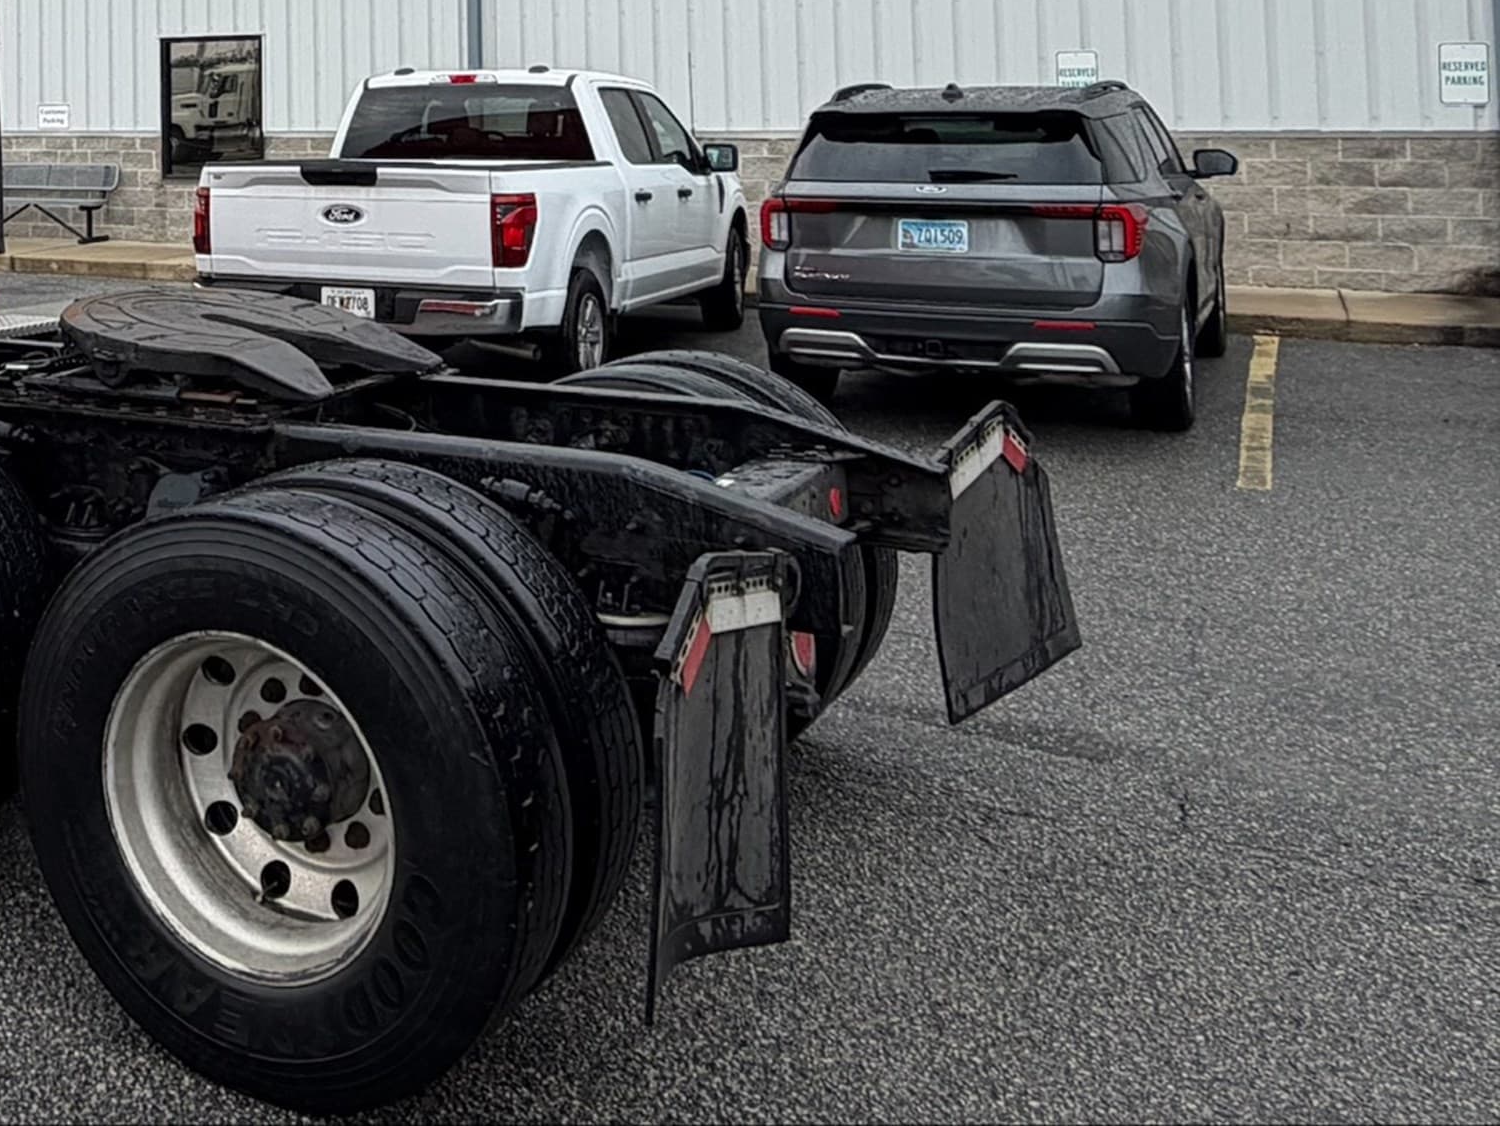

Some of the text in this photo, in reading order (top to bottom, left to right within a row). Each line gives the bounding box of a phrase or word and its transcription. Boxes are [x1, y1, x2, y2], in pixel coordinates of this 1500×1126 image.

[1441, 61, 1486, 72] RESERVED
[1059, 68, 1096, 77] RESERVED
[1445, 75, 1485, 86] PARKING
[328, 208, 356, 221] Ford
